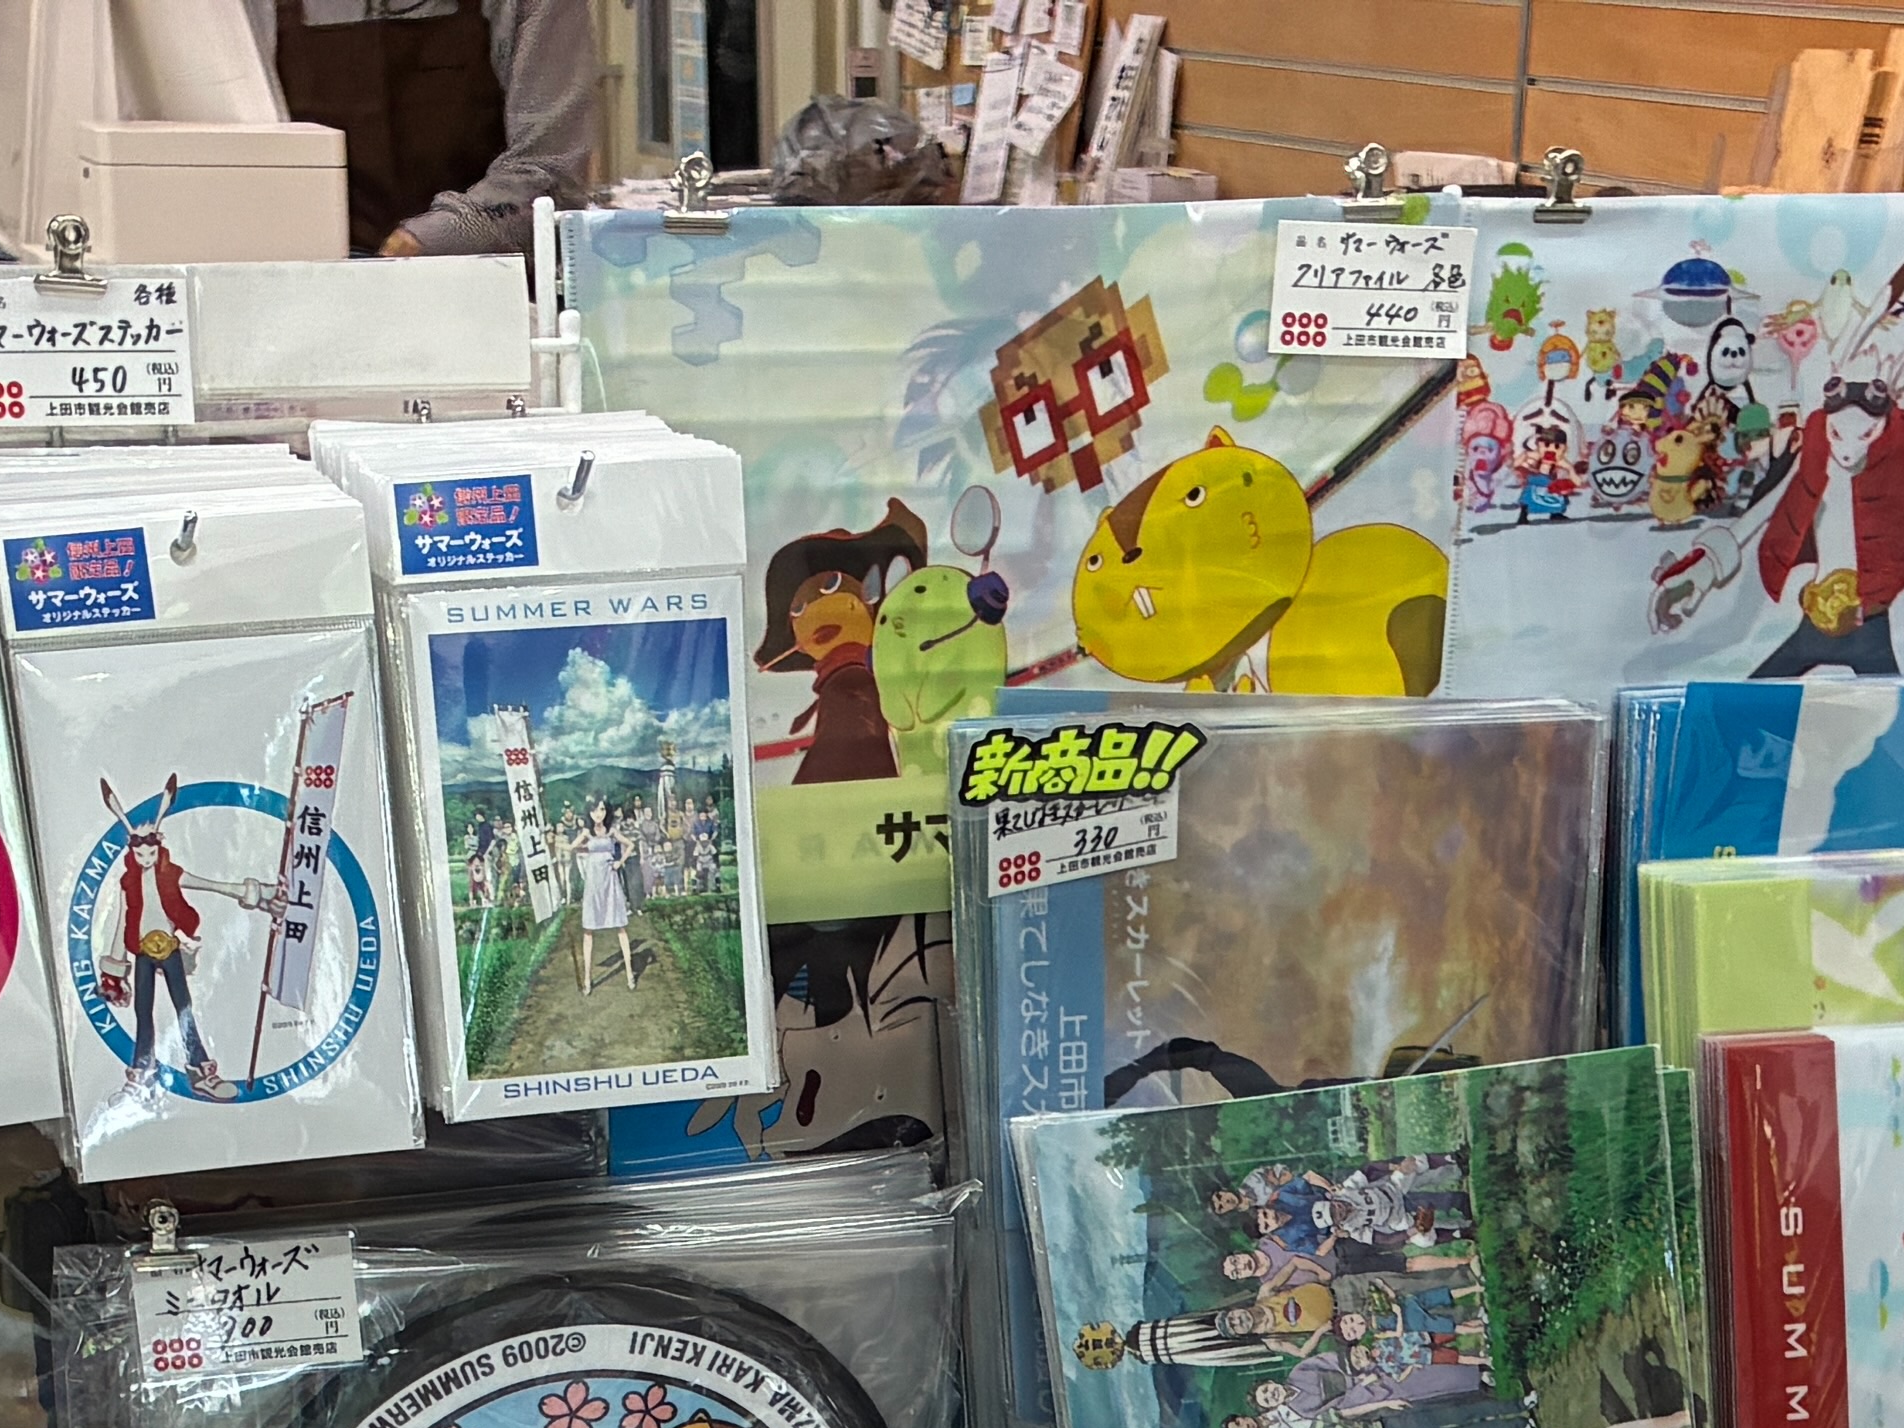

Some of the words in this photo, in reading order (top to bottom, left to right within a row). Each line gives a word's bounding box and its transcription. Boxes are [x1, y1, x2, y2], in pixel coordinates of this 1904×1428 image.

[1293, 263, 1409, 287] クリアファイル
[134, 282, 177, 305] 各種
[1366, 303, 1418, 326] 440
[71, 366, 127, 393] 450
[46, 402, 170, 416] 上田市観光会館売店
[415, 528, 523, 554] サマーウォーズ
[427, 553, 524, 567] オリジナルステッカー
[29, 581, 139, 610] サマーウォーズ
[448, 599, 592, 624] SUMMER
[609, 593, 708, 614] WARS
[42, 606, 141, 623] オリジナルステッカー
[965, 729, 1199, 801] 新商品!!
[513, 779, 550, 886] 信州上田
[1074, 826, 1119, 856] 330
[285, 804, 326, 943] 信州上田
[1057, 844, 1157, 875] 上田市観光会館売店
[69, 838, 121, 941] KAZMA
[71, 961, 117, 1034] KING
[262, 1003, 364, 1095] SHINSHU
[356, 915, 377, 992] UEDA
[504, 1073, 633, 1099] SHINSHU
[642, 1065, 719, 1086] UEDA
[222, 1341, 337, 1363] 上田市観光会館売店
[502, 1331, 586, 1367] ©2009
[629, 1330, 700, 1366] KENJI
